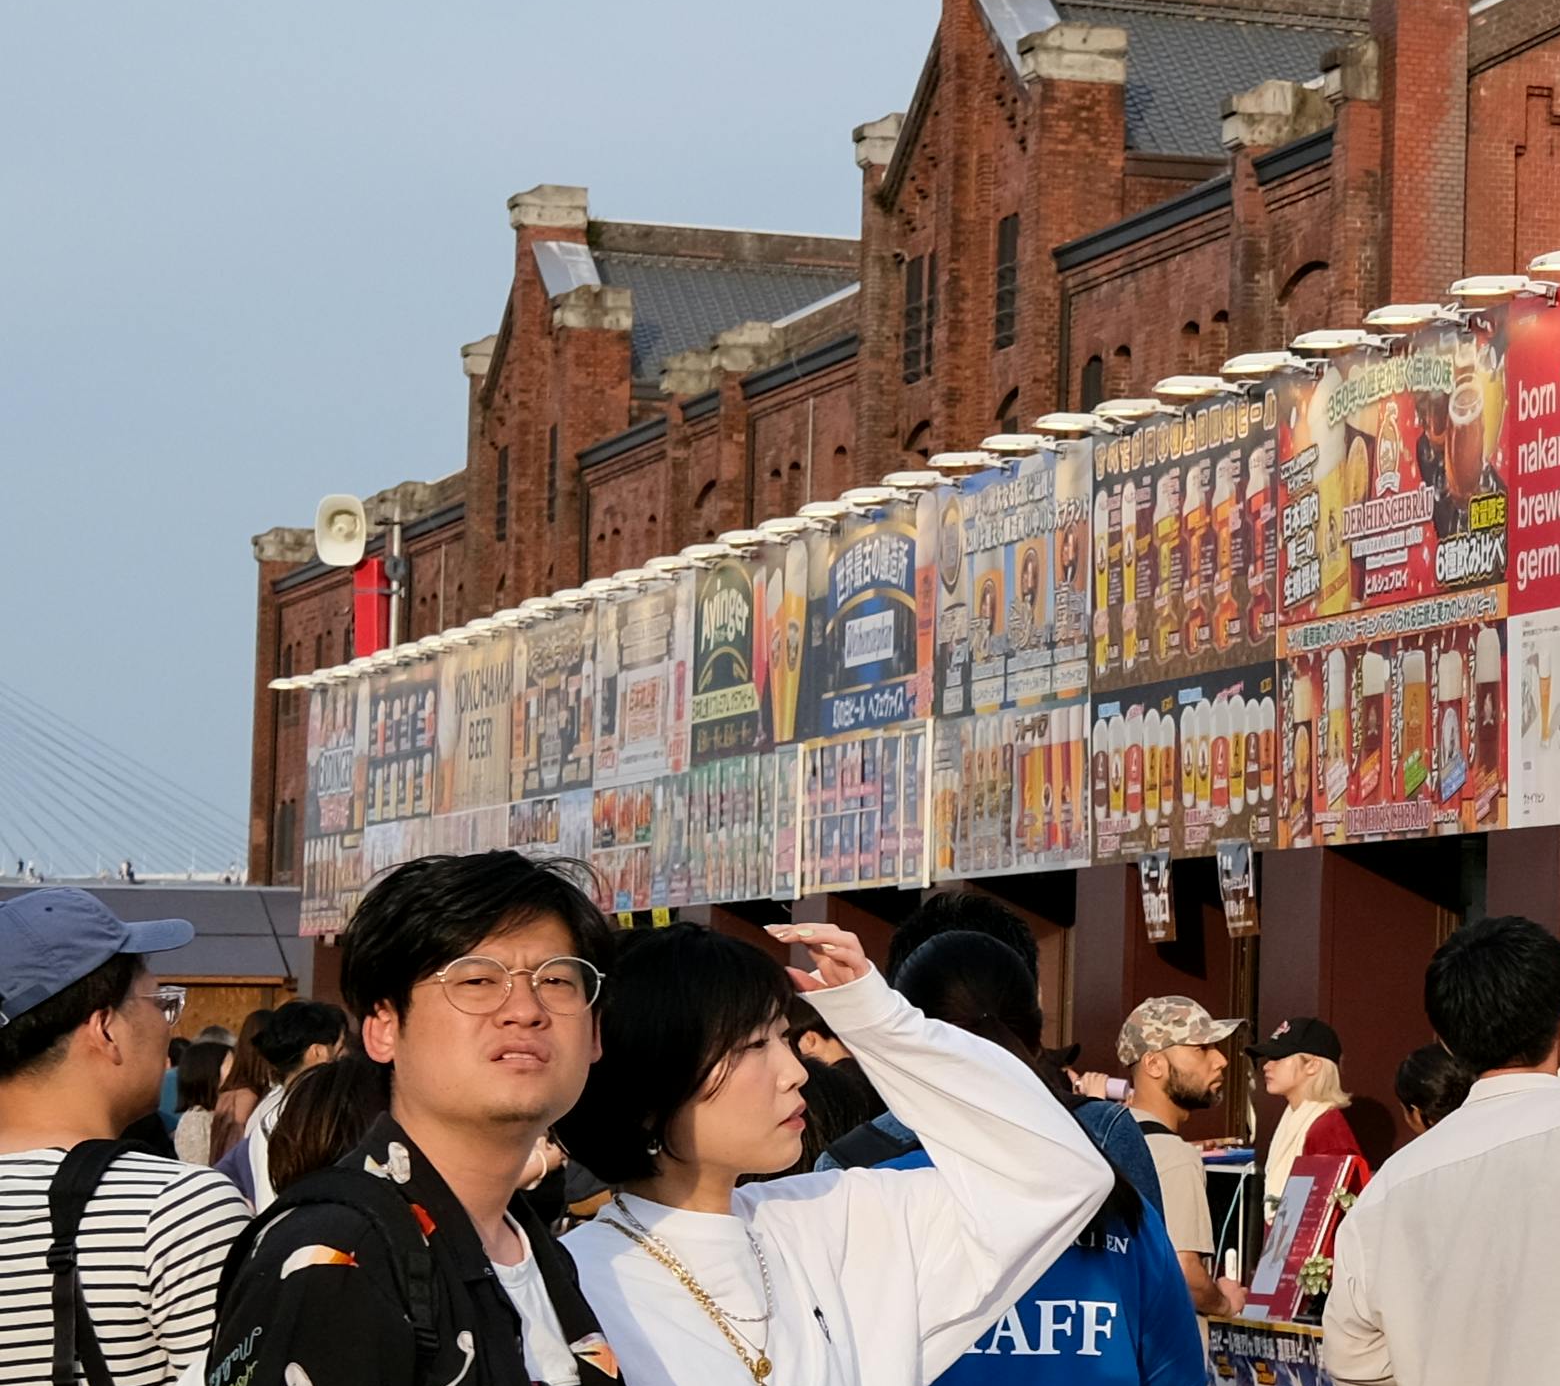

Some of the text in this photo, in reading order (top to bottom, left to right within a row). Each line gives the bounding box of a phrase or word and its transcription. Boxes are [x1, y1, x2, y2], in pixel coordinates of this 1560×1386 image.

[1517, 378, 1554, 422] born
[1283, 491, 1320, 538] 日本国内
[1343, 480, 1435, 537] DER HIRSCHBRÄU
[1470, 495, 1507, 530] 数量限定
[1435, 530, 1506, 582] 6種飲み比べ
[701, 578, 749, 654] Ayinger
[453, 662, 515, 715] YOKOHAMA
[468, 716, 494, 761] BEER
[970, 1300, 1118, 1357] AFF
